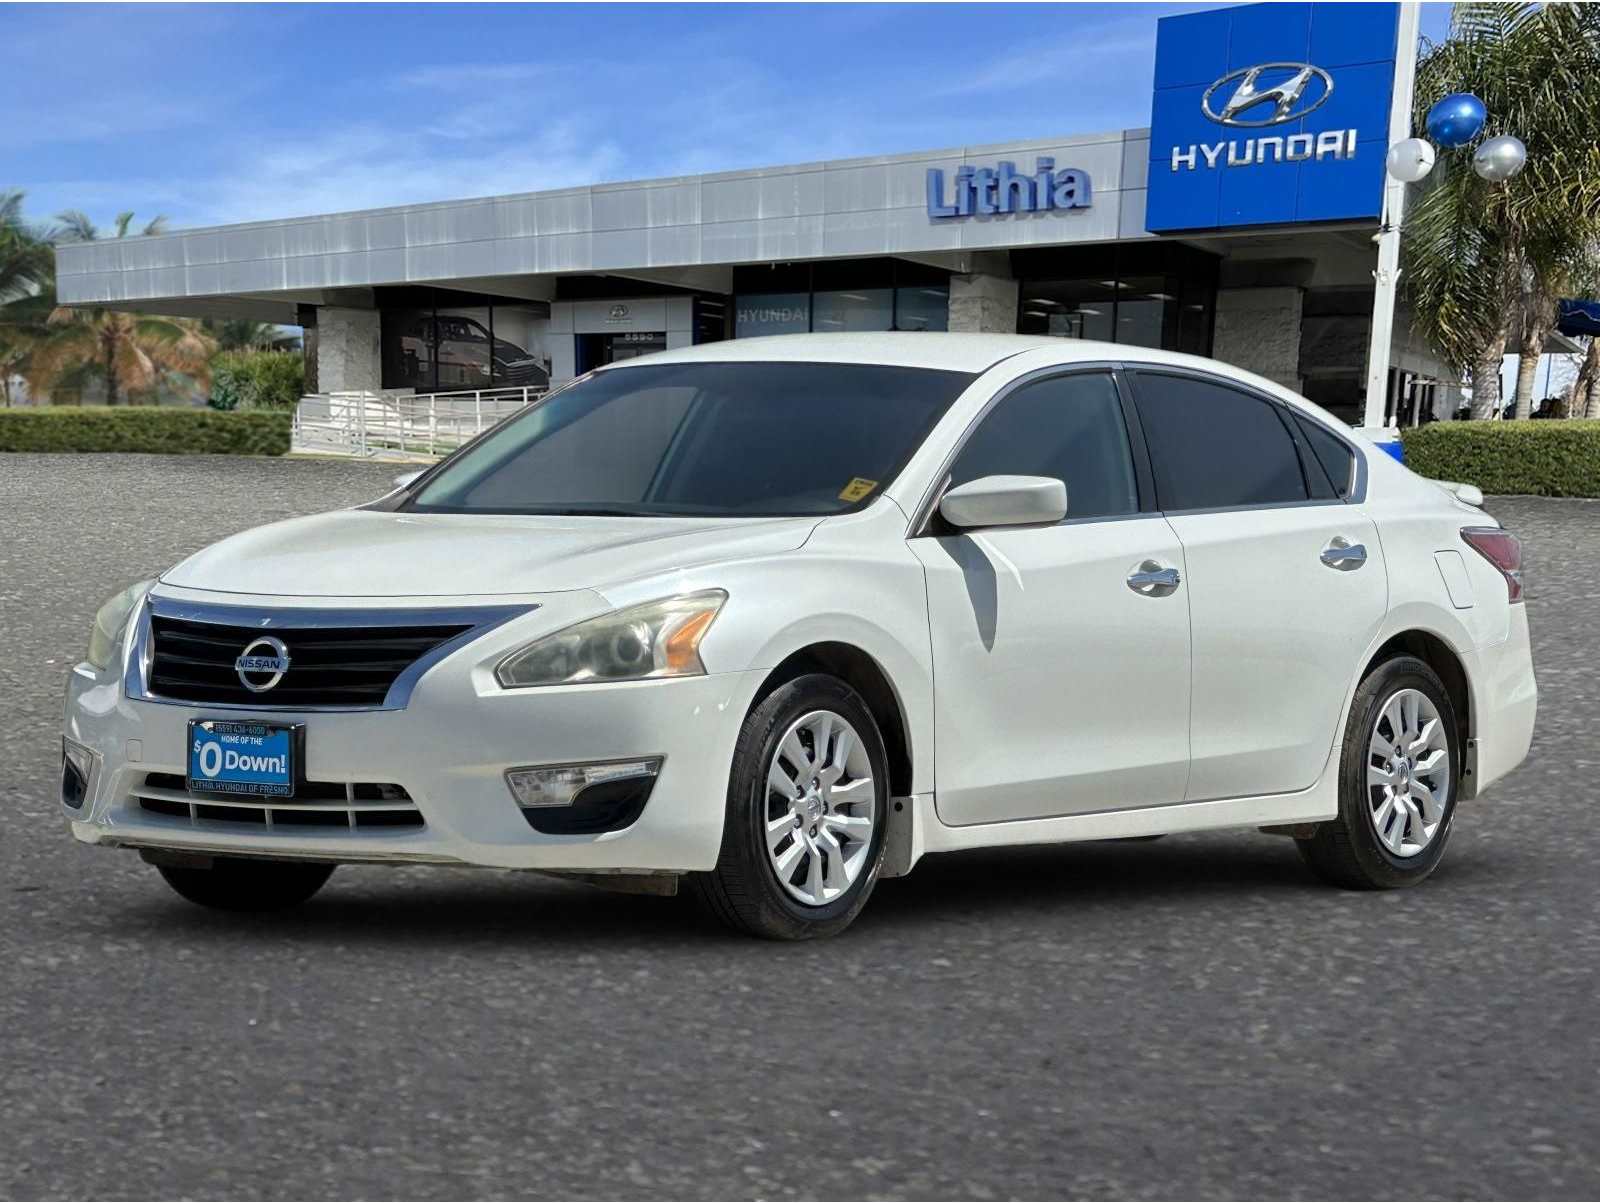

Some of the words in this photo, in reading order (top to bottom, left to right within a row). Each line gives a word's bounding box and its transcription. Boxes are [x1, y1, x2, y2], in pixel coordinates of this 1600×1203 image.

[1171, 129, 1357, 171] HYUNDAI
[926, 157, 1092, 217] Lithia
[737, 307, 808, 322] HYUNDAI
[239, 659, 281, 669] NISSAN
[221, 735, 239, 744] HOME
[240, 736, 249, 744] OF
[250, 737, 263, 745] THE
[225, 750, 286, 773] Down!
[215, 782, 247, 792] HYUNDAI
[248, 784, 258, 793] OF
[259, 785, 288, 794] FRESNO
